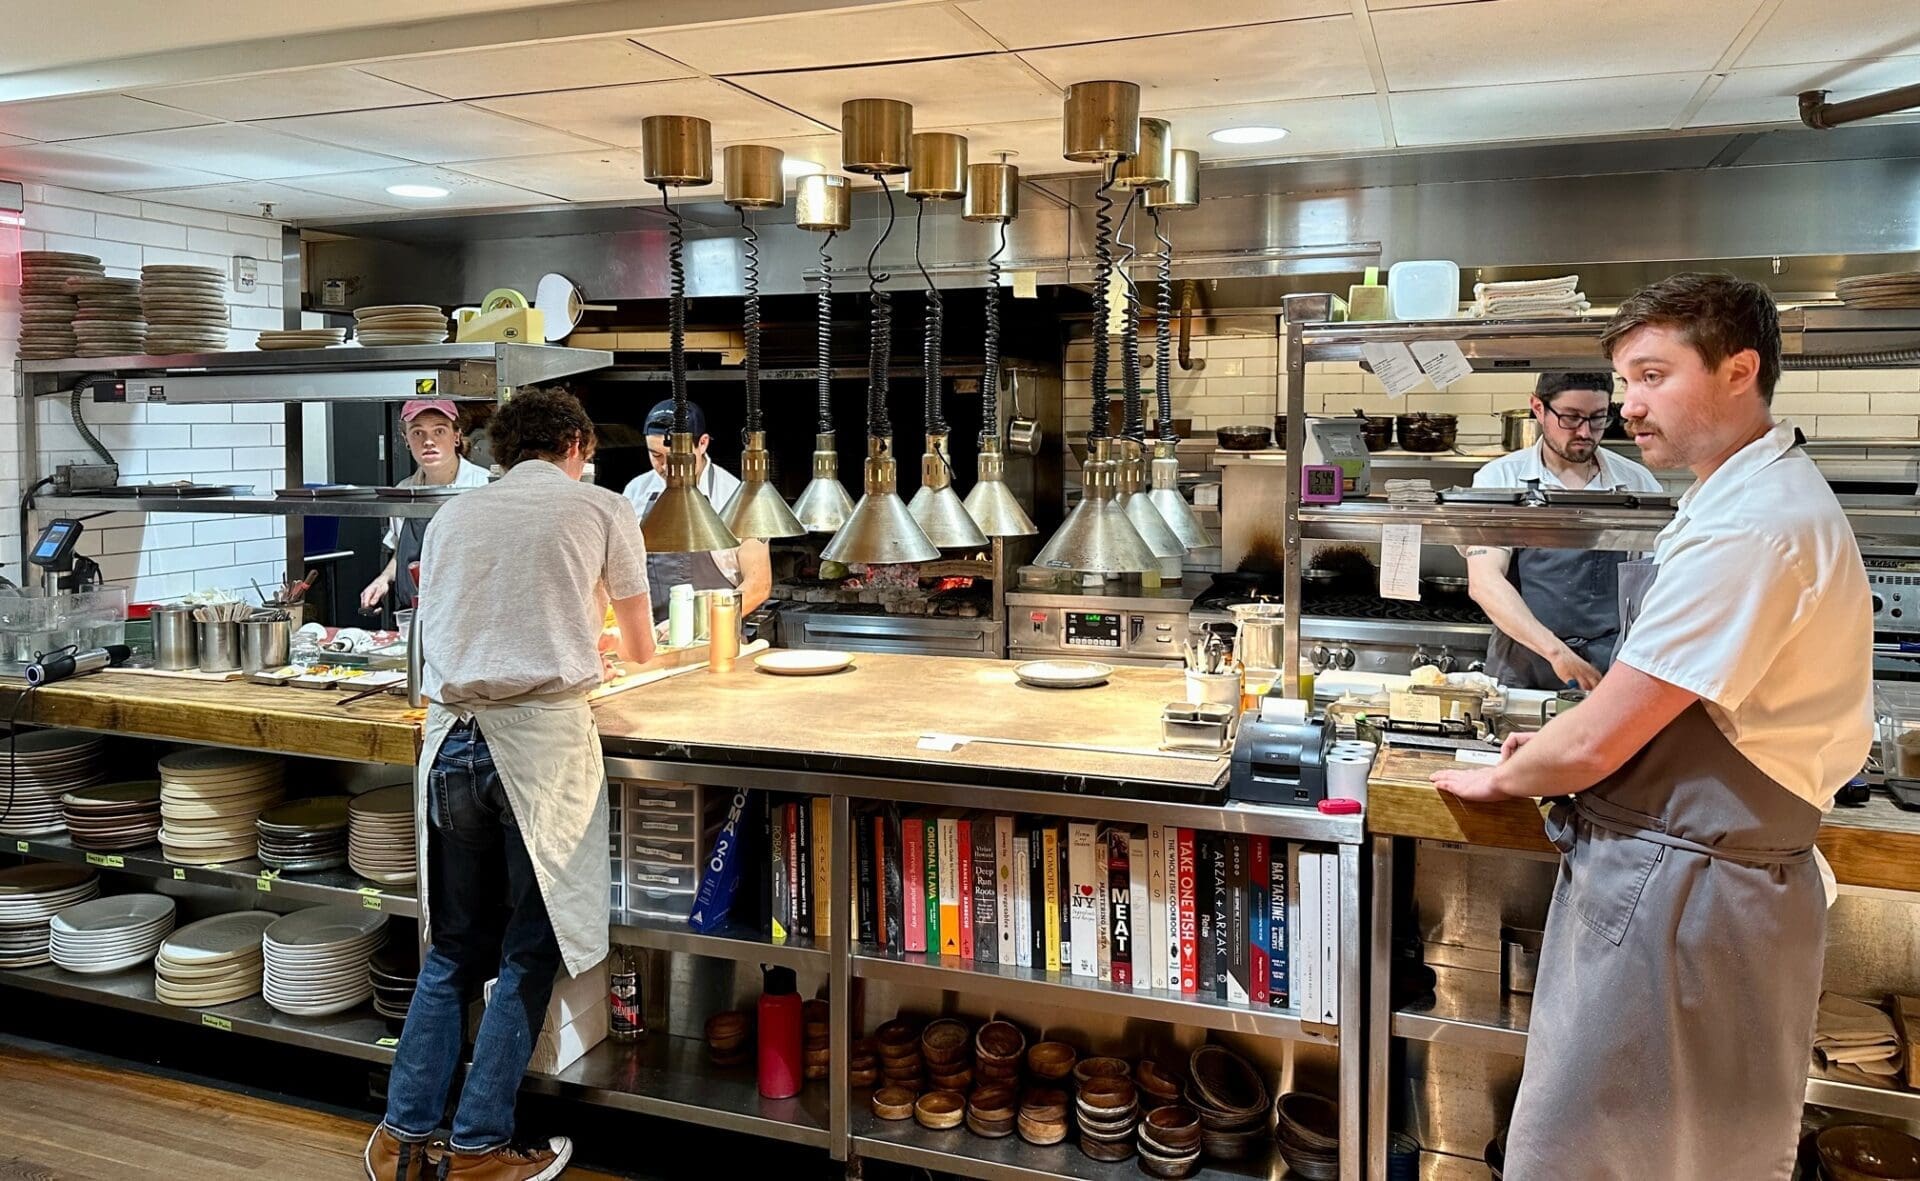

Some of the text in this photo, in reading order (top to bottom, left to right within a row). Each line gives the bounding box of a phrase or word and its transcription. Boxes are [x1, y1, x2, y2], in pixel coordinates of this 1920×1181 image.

[710, 786, 749, 872] NOMA 2.0
[773, 825, 781, 863] ROBATA
[927, 826, 936, 869] ORIGINAL
[818, 834, 826, 883] JAPAN
[862, 859, 870, 882] BIBLE
[909, 842, 917, 873] preserving
[975, 866, 994, 877] Deep
[1047, 848, 1055, 904] MOMOFUKU
[1153, 831, 1161, 898] BRAS
[1214, 851, 1226, 895] ARZAK
[909, 887, 917, 914] japanese
[928, 871, 936, 899] FLAVA
[975, 886, 995, 896] Roots
[977, 877, 992, 886] Run
[1074, 884, 1080, 895] I
[1180, 840, 1195, 940] TAKE ONE FISH
[1271, 862, 1284, 921] BAR TARTINE
[1072, 895, 1095, 909] NY
[1111, 888, 1130, 951] MEAT
[1216, 911, 1227, 956] ARZAK
